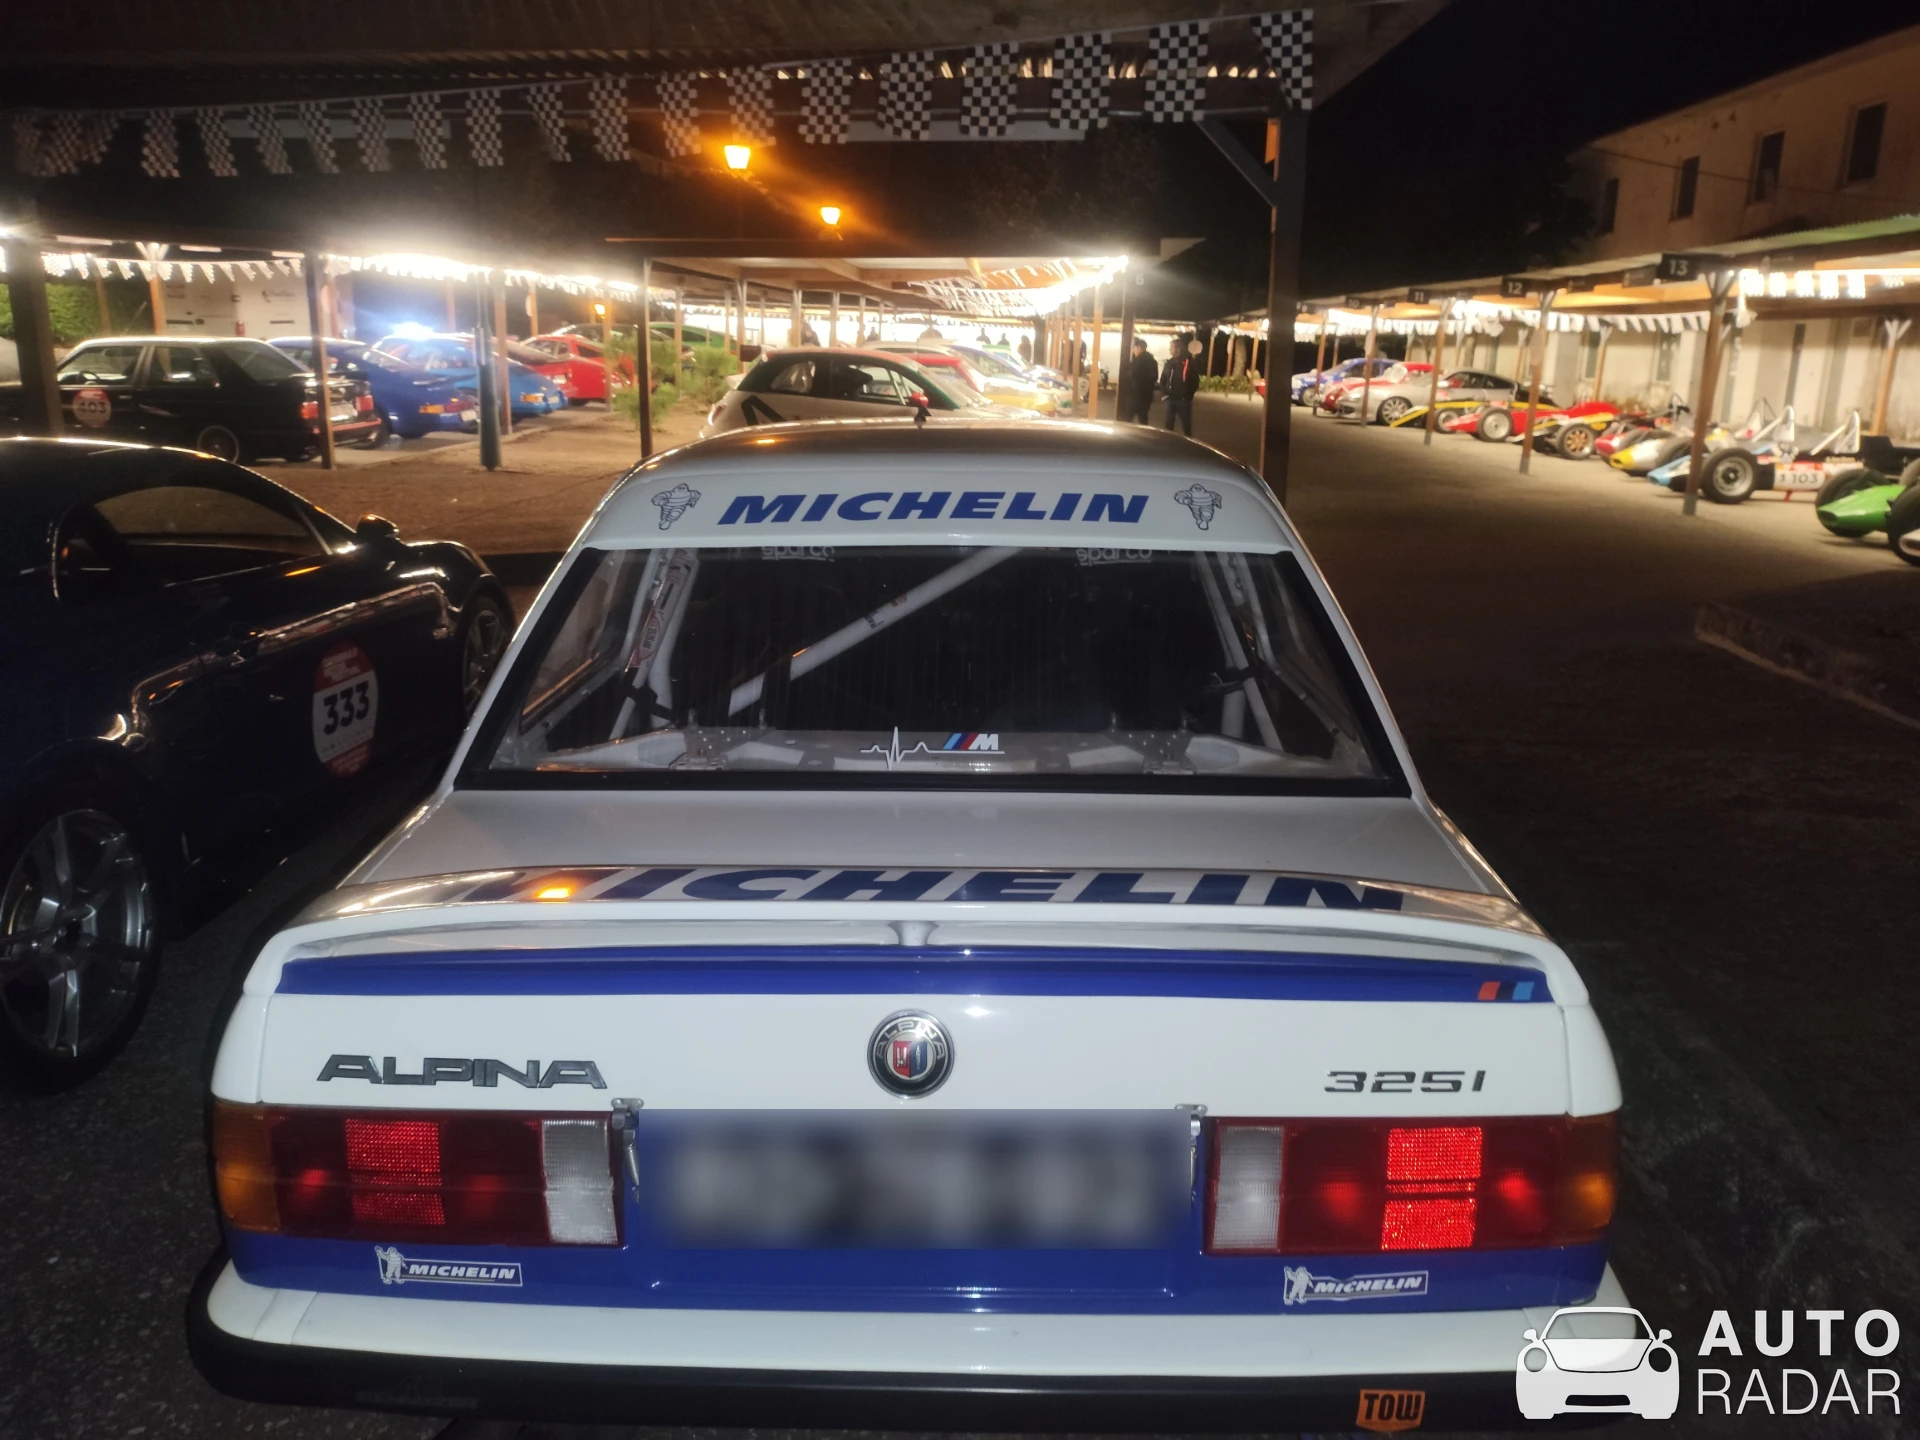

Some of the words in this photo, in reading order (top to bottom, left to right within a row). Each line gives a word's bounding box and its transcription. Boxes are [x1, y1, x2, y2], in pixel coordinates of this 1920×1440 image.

[1669, 259, 1689, 276] 13
[1507, 281, 1523, 295] 12
[79, 400, 107, 414] 403
[1791, 473, 1819, 484] 103
[717, 491, 1149, 525] MICHELIN
[323, 680, 370, 735] 333
[440, 867, 1404, 912] MICHELIN
[316, 1054, 608, 1089] ALPINA
[408, 1264, 516, 1280] MICHELIN
[1313, 1276, 1423, 1294] MICHELIN
[1363, 1393, 1422, 1421] TOW
